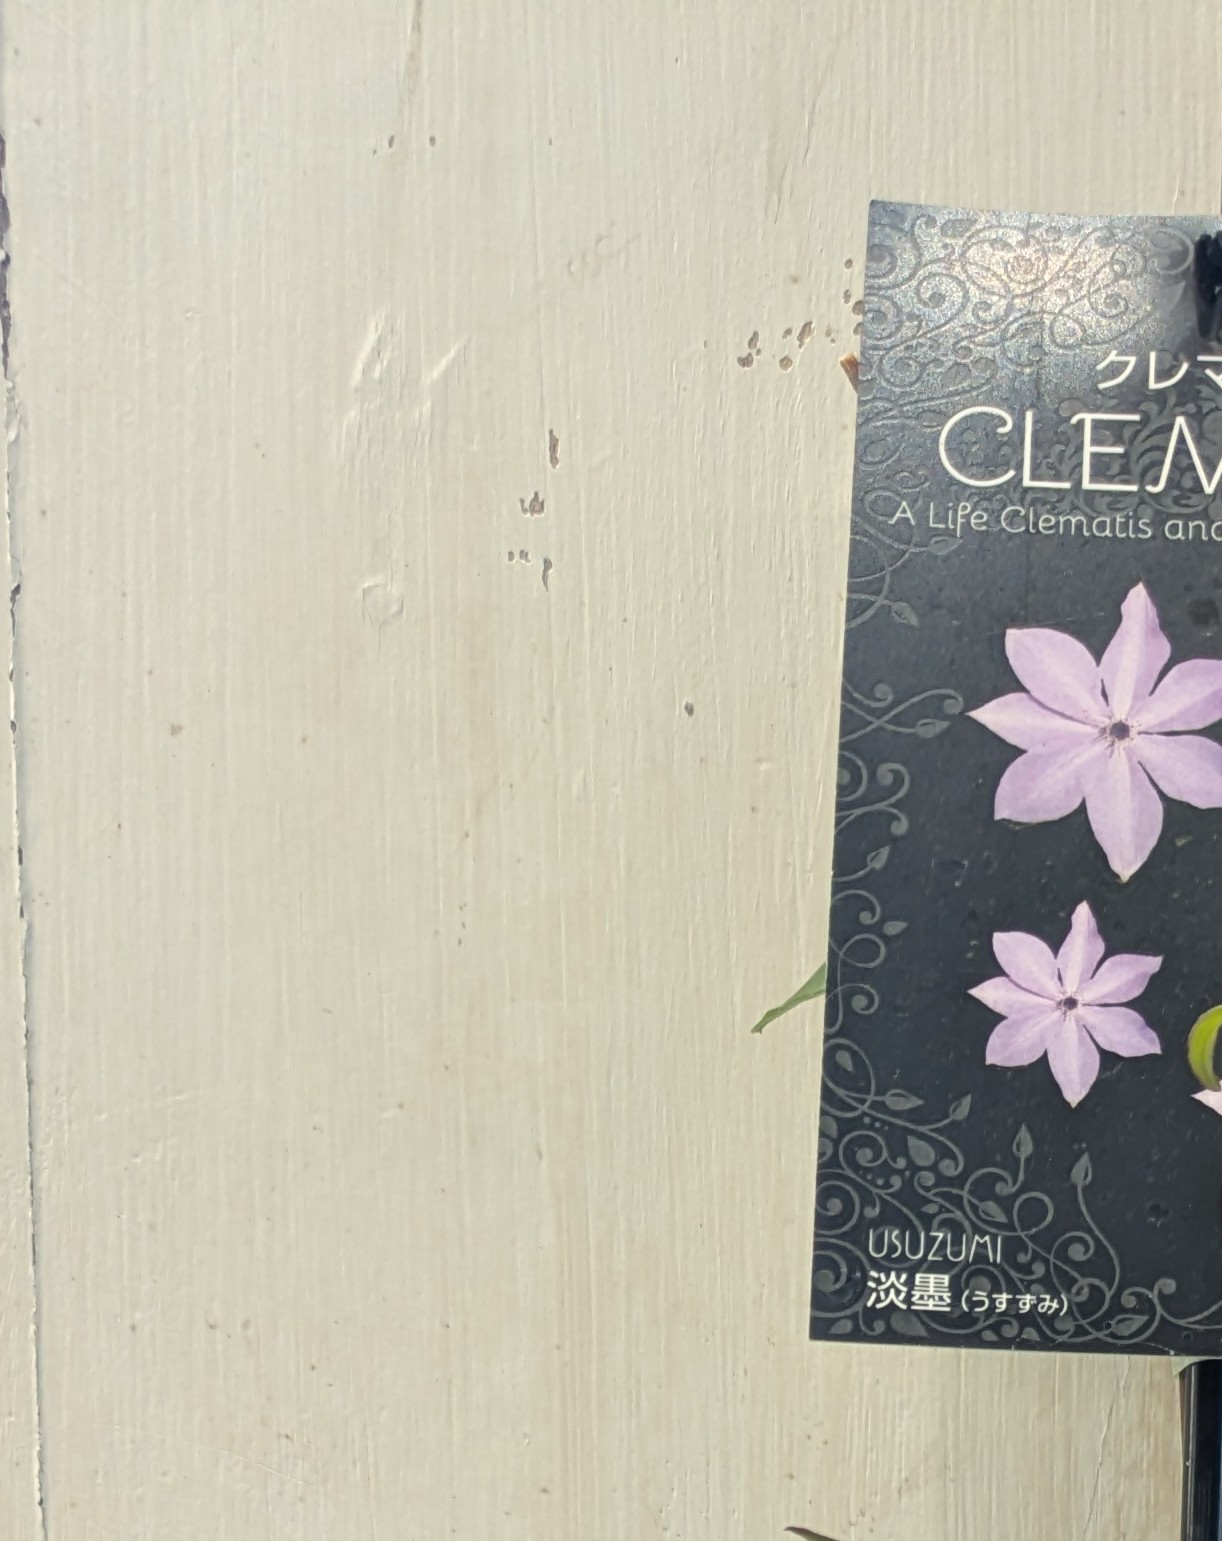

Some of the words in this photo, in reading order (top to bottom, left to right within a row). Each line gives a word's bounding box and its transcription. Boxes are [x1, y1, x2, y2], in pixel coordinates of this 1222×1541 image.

[888, 501, 916, 527] A
[928, 501, 988, 536] Life
[1001, 504, 1153, 540] Clematis
[867, 1227, 1002, 1264] USUZUMI
[866, 1270, 951, 1312] 淡墨
